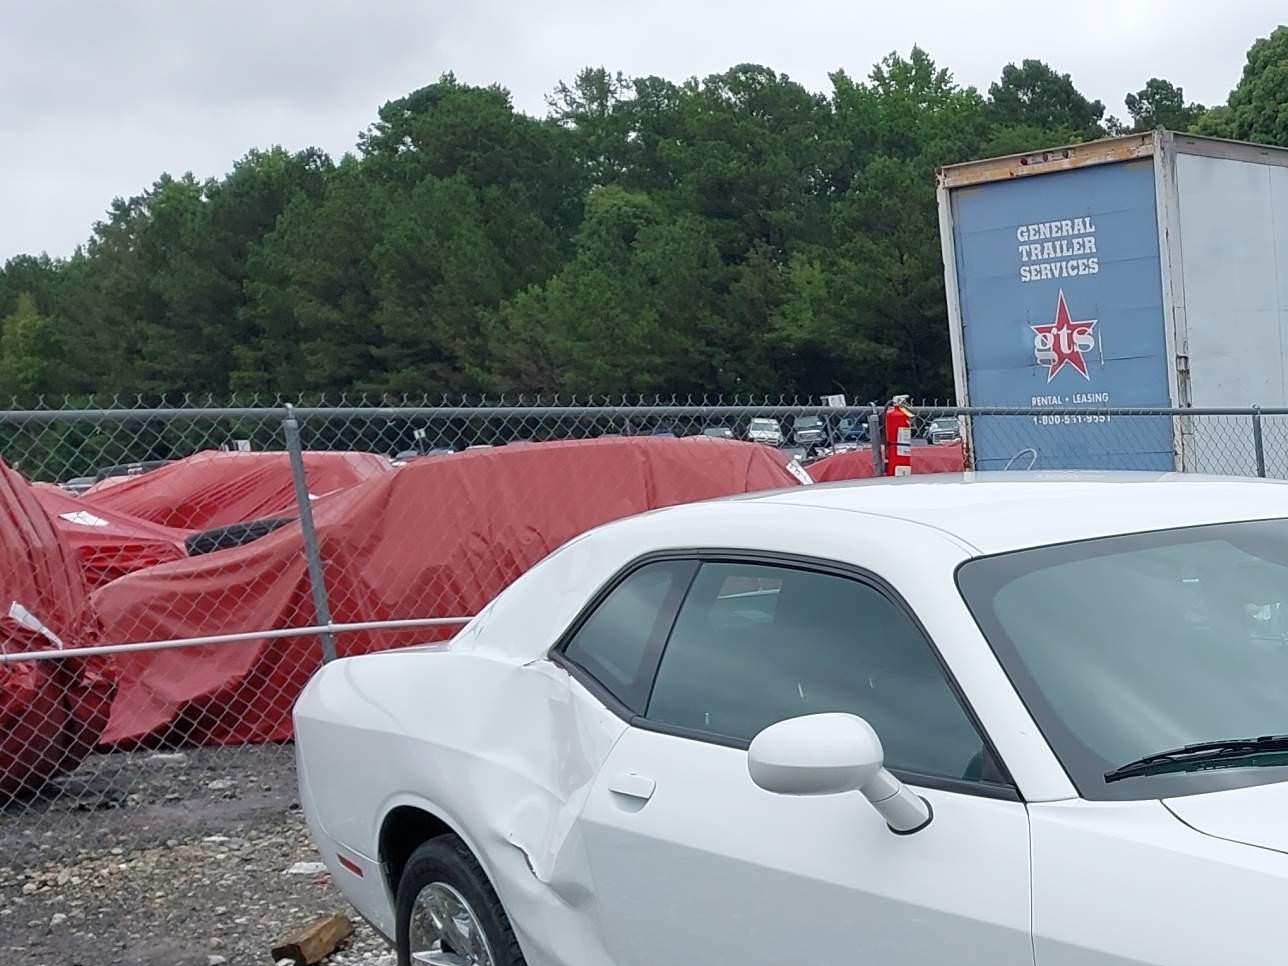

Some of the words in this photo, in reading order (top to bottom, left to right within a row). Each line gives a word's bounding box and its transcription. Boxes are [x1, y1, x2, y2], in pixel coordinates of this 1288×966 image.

[1017, 217, 1096, 242] GENERAL
[1018, 236, 1097, 262] TRAILER
[1020, 257, 1099, 282] SERVICES
[1034, 323, 1095, 366] gts
[1031, 395, 1062, 407] RENTAL
[1072, 392, 1109, 404] LEASING
